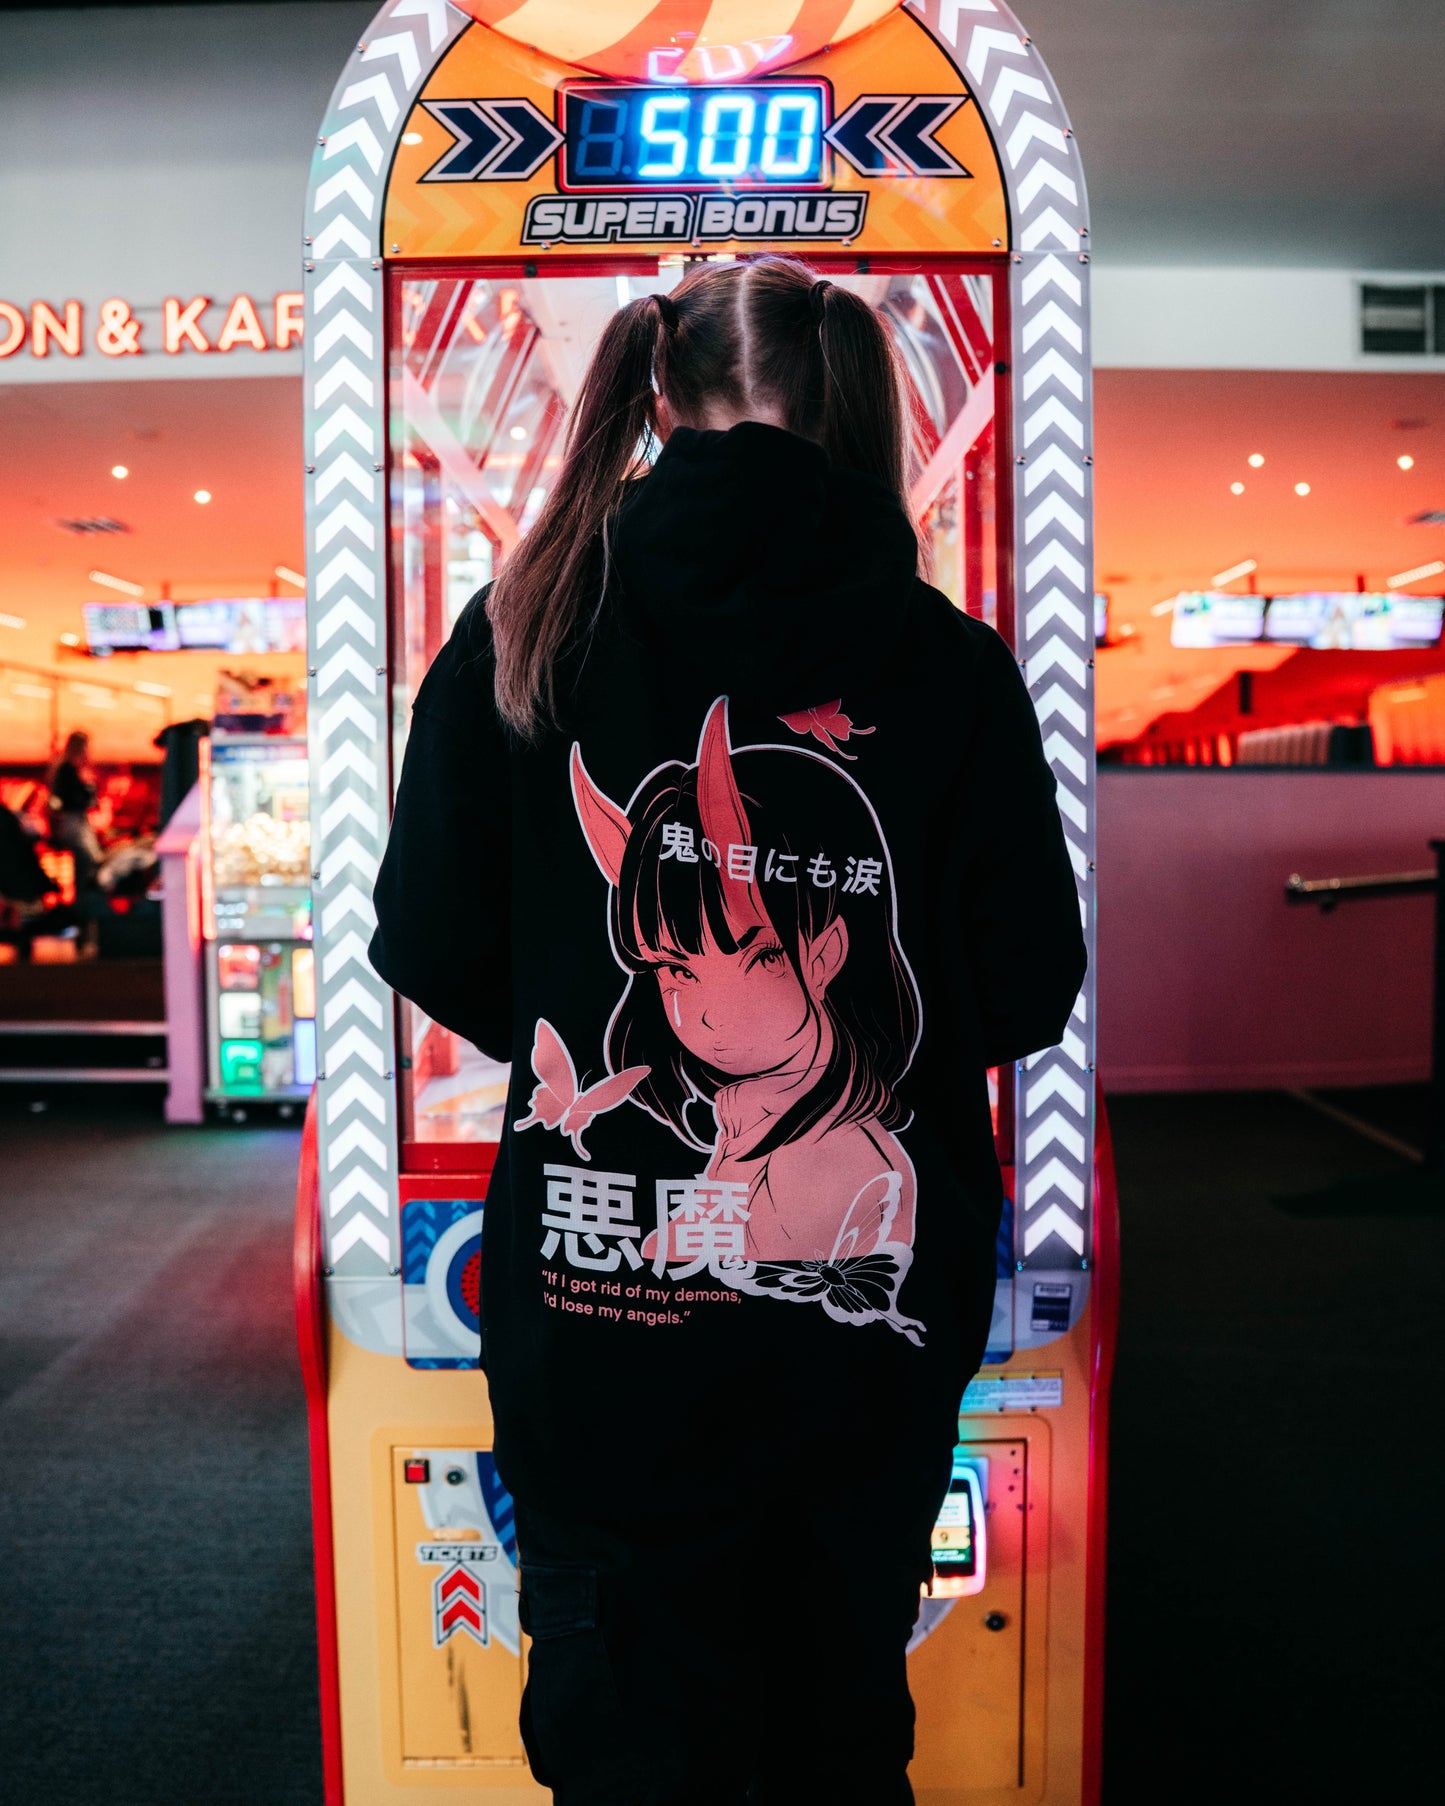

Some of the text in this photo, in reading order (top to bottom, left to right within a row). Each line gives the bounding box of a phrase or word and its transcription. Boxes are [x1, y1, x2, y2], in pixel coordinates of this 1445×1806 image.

[637, 94, 818, 177] 500
[531, 199, 859, 237] SUPER BONUS
[95, 298, 145, 359] &
[658, 821, 884, 897] 鬼の目にも涙
[539, 1163, 757, 1281] 悪魔
[561, 1273, 566, 1288] I
[570, 1279, 597, 1294] got
[600, 1281, 621, 1297] rid
[625, 1284, 642, 1299] of
[645, 1288, 671, 1305] my
[674, 1287, 742, 1304] demons,
[561, 1296, 594, 1315] lose
[598, 1305, 623, 1322] my
